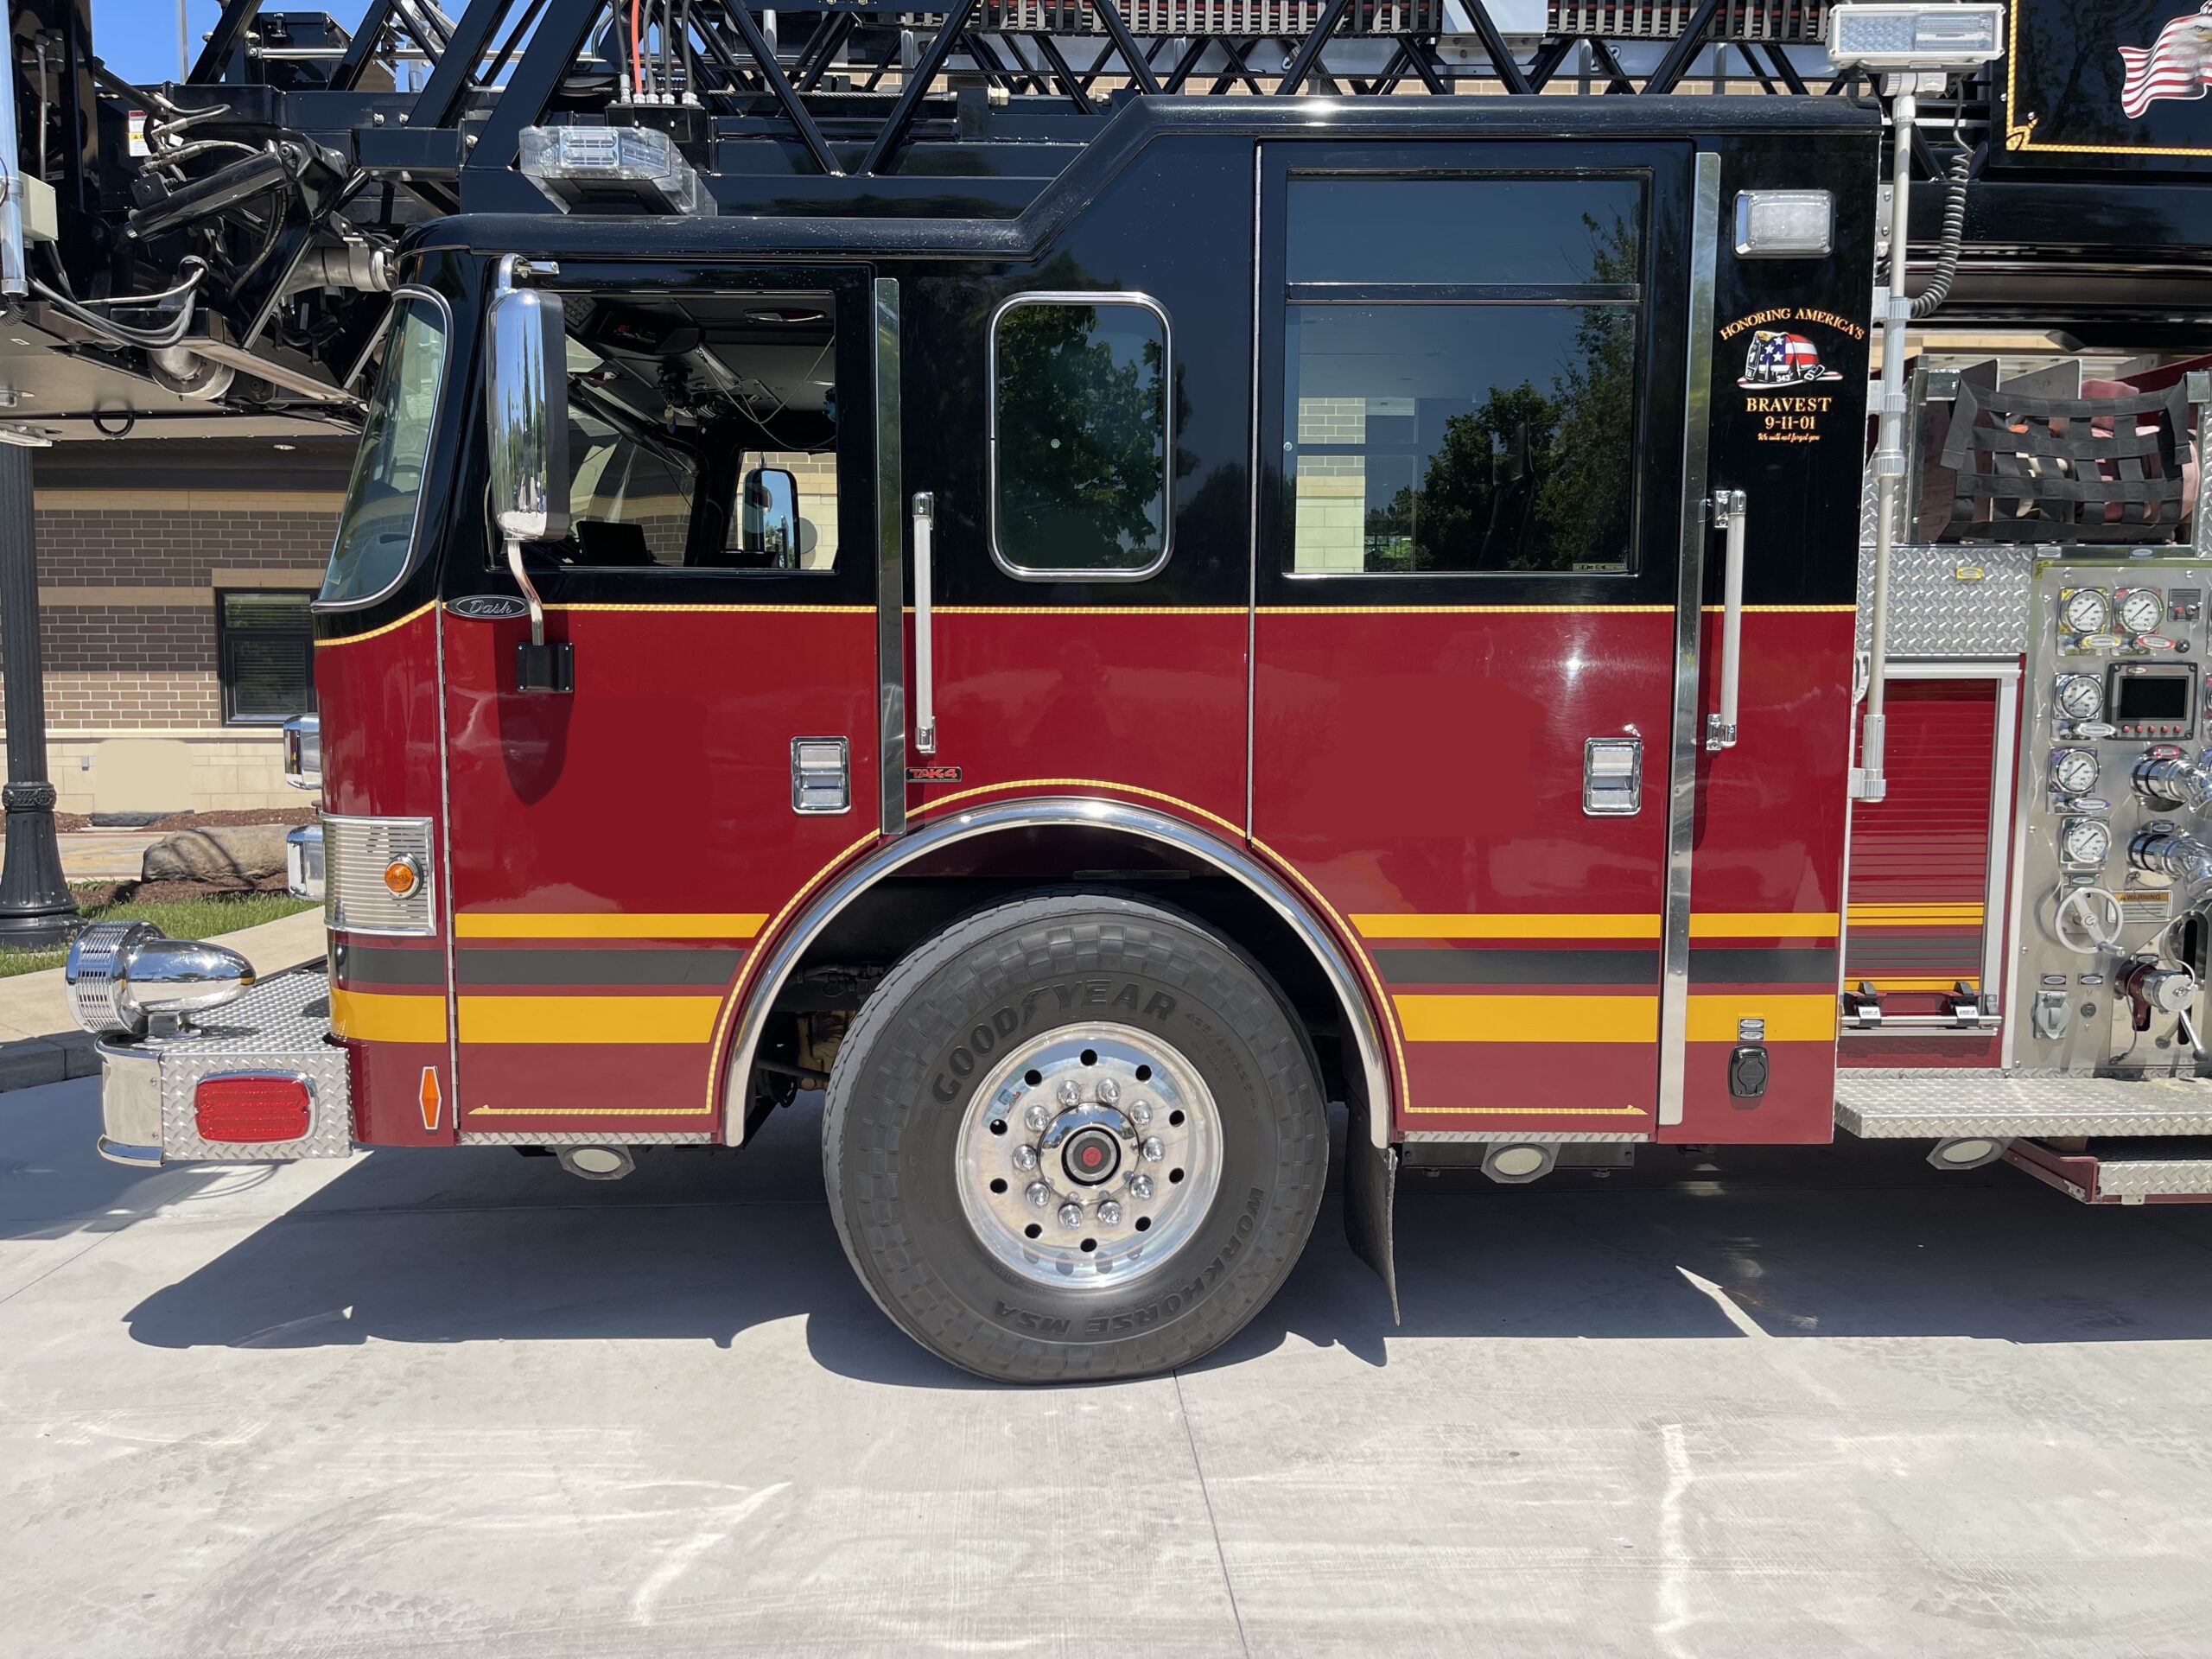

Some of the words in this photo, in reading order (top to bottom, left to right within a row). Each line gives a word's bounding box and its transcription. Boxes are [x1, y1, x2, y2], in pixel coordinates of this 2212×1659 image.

[1719, 308, 1791, 341] HONORING
[1795, 308, 1866, 340] AMERICA'S
[1776, 374, 1791, 383] 343
[1745, 397, 1832, 413] BRAVEST
[1764, 416, 1815, 430] 9-11-01
[469, 599, 512, 614] Dash
[931, 978, 1180, 1104] GOODYEAR
[1086, 1185, 1265, 1338] WORKHORSE
[995, 1300, 1073, 1337] MSA
